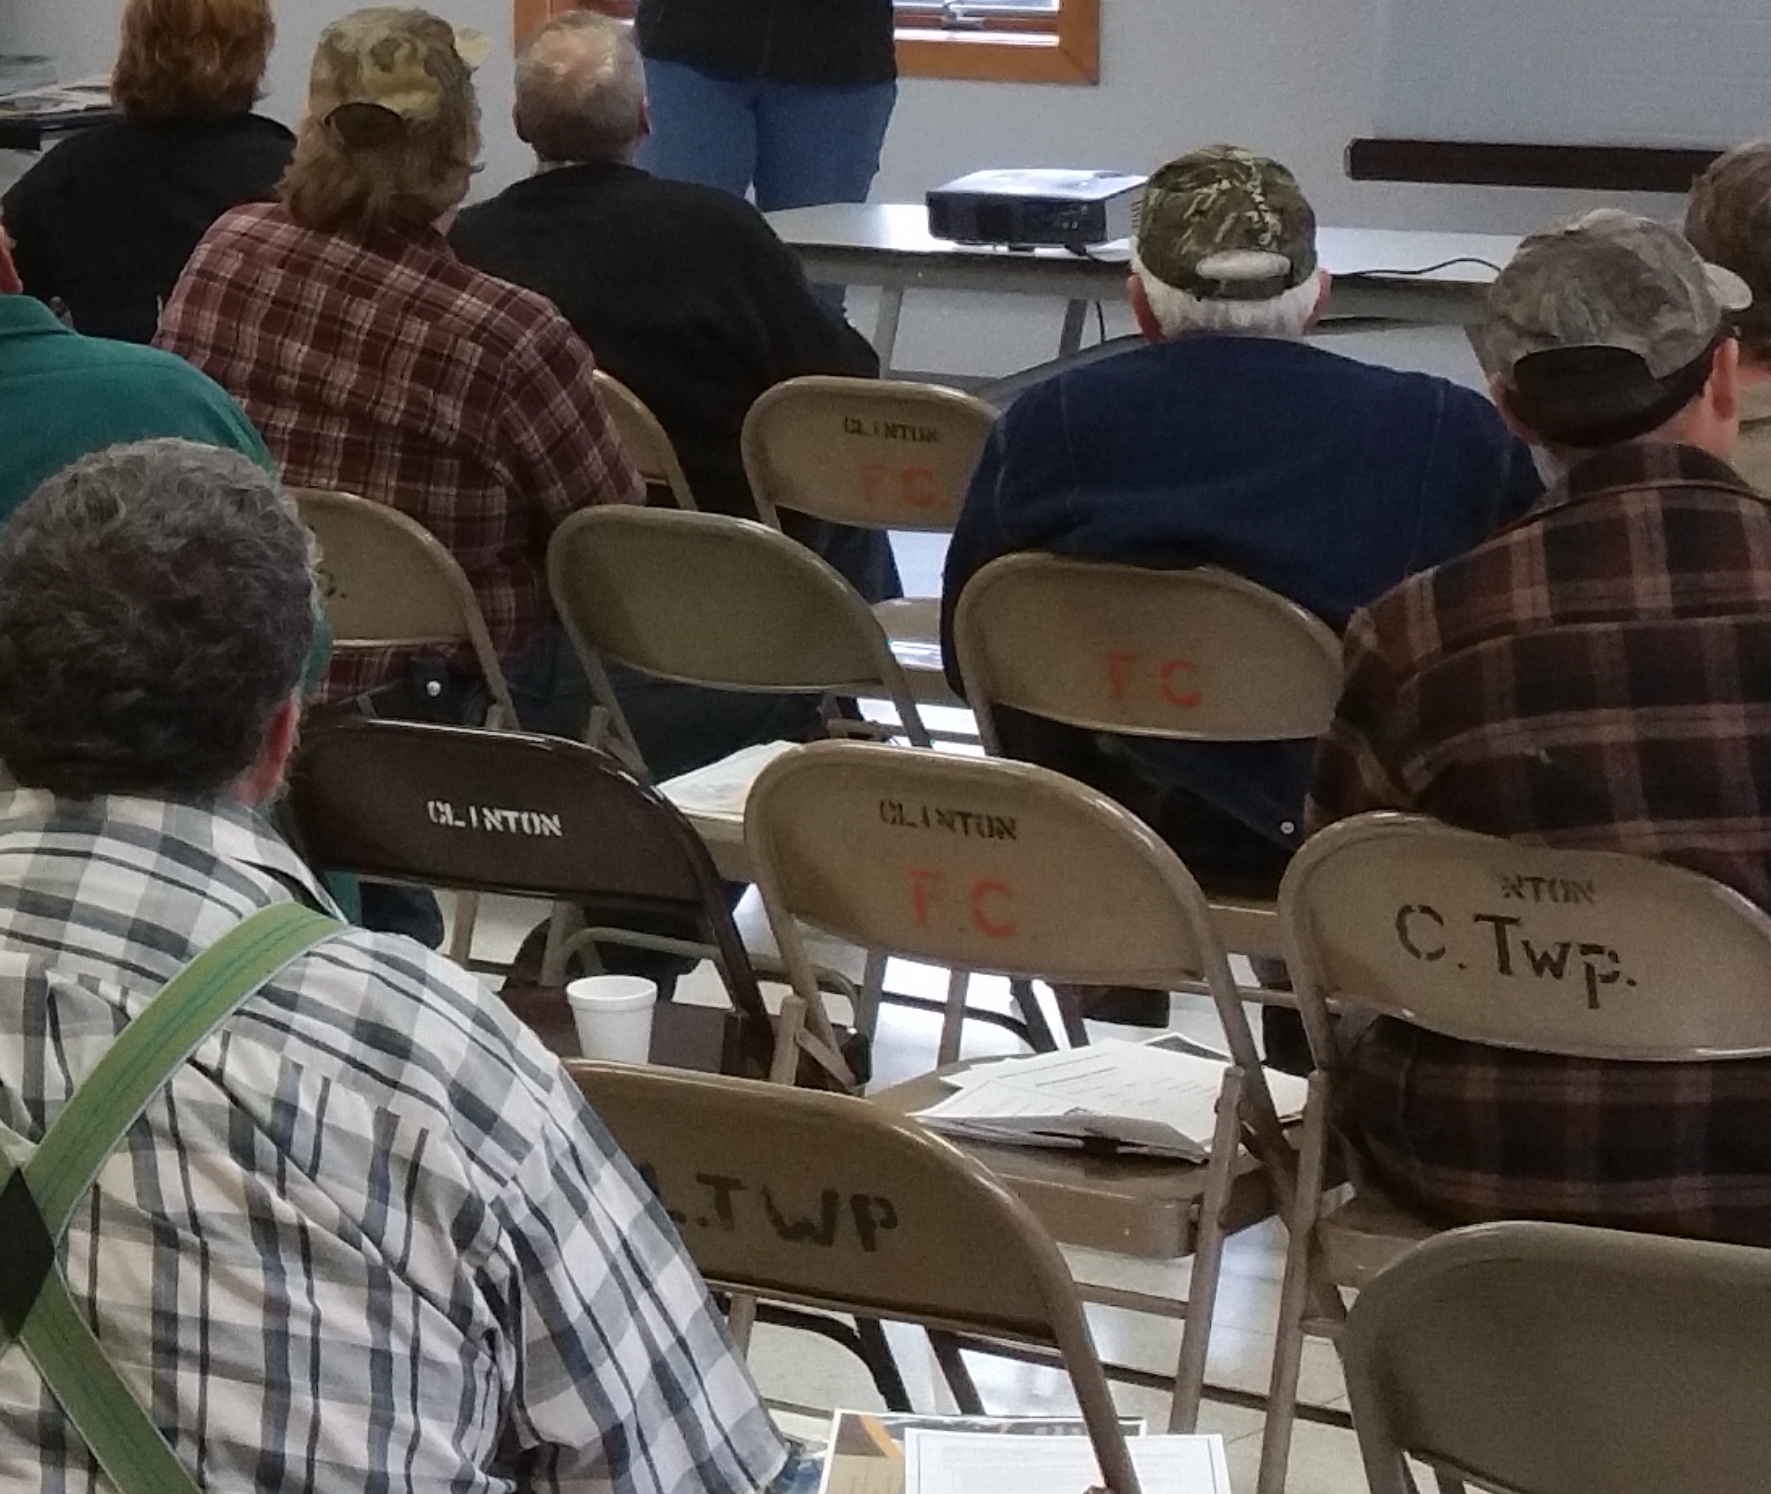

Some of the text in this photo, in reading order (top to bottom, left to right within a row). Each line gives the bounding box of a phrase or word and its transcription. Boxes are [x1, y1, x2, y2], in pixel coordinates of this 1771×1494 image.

[427, 800, 563, 837] CLINTON
[879, 800, 1017, 840] CLINTON
[1473, 913, 1638, 1009] Twp.
